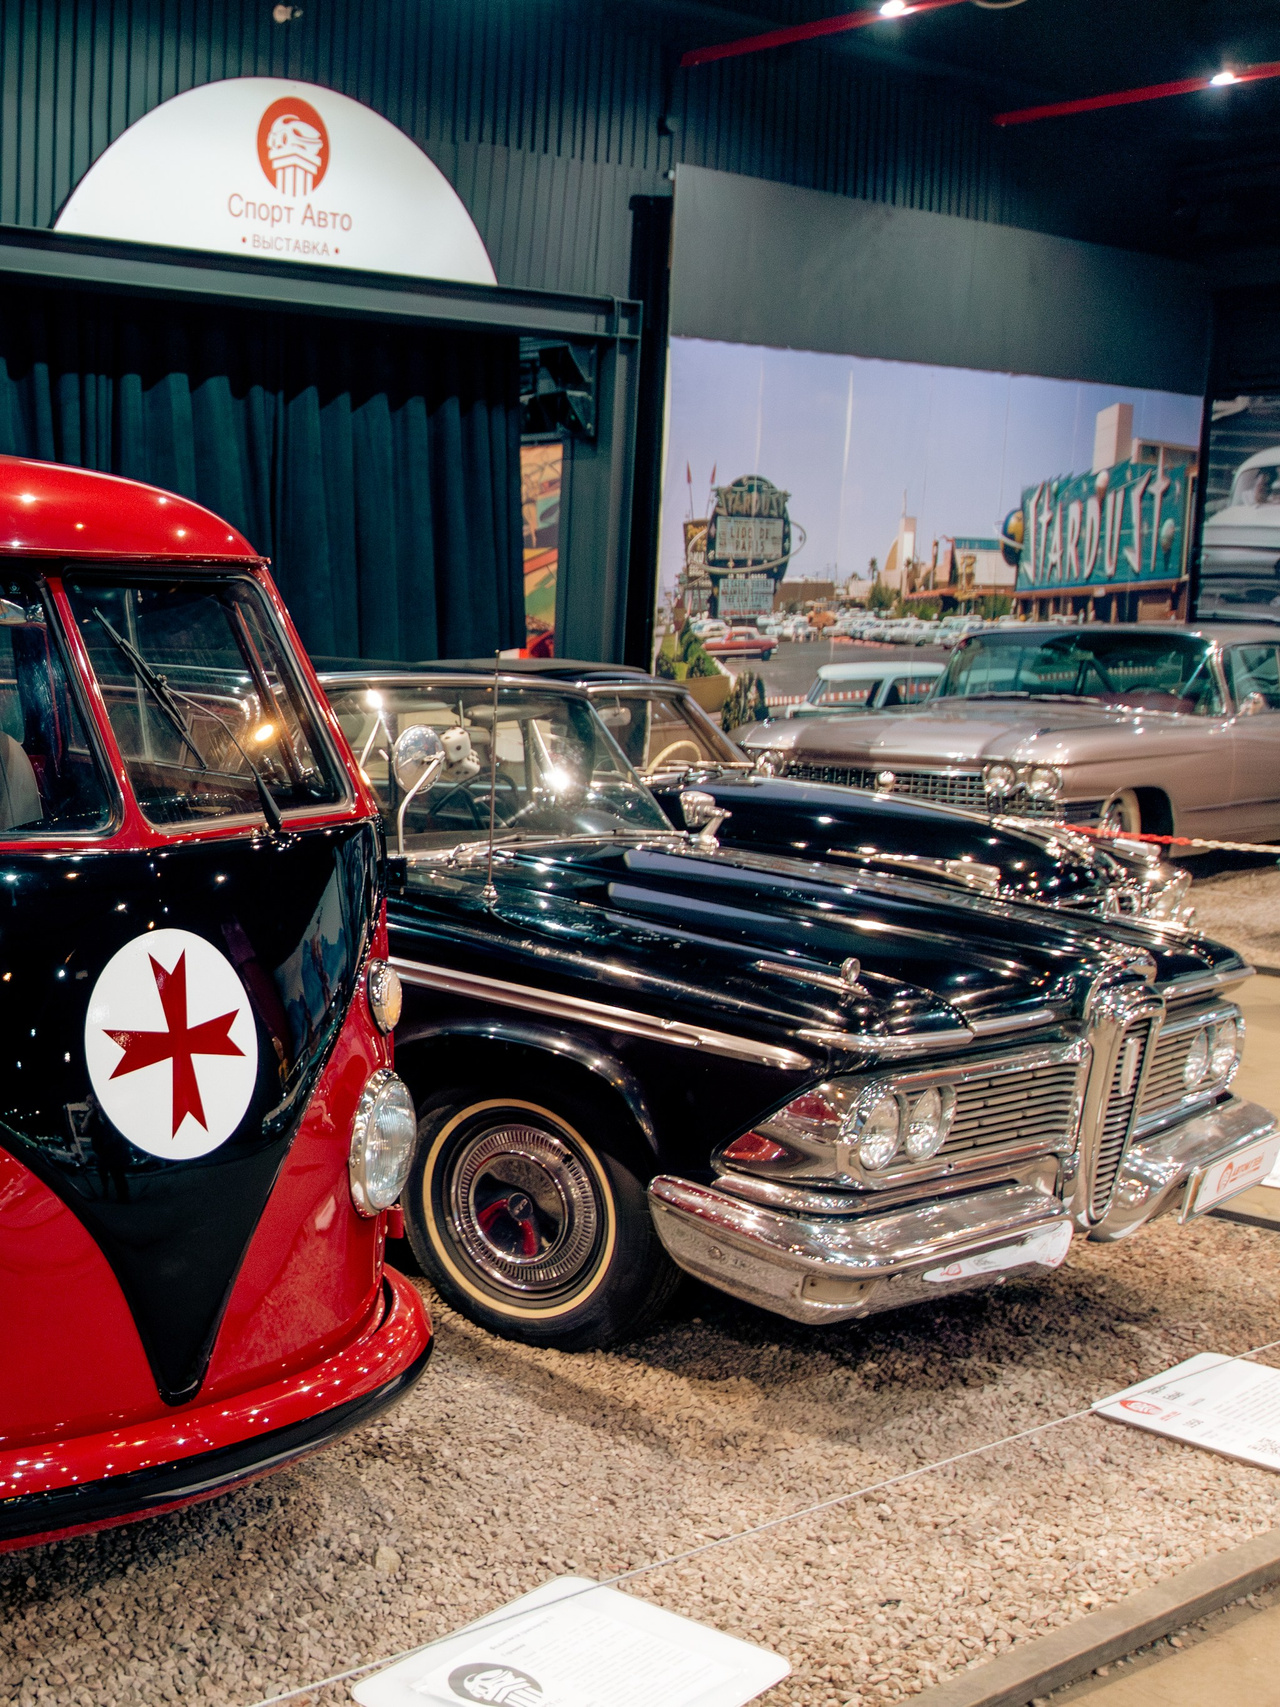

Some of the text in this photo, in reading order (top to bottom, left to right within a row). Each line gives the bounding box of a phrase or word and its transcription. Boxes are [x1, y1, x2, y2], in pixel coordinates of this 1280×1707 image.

[228, 193, 352, 231] Спорт Авто
[252, 234, 330, 256] ВЫСТАВКА
[1023, 446, 1170, 586] STARDUST
